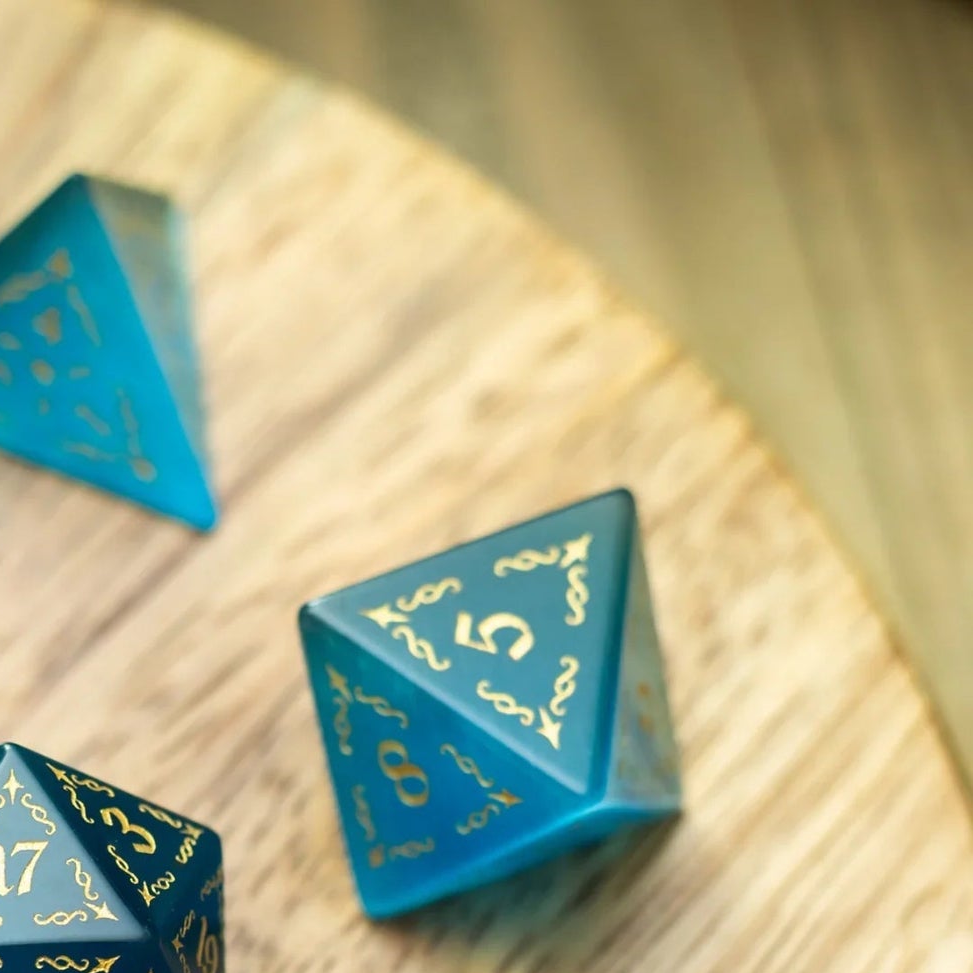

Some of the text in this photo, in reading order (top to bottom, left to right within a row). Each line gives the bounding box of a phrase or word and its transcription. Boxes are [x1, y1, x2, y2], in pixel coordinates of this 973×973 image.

[455, 610, 534, 661] 5
[378, 740, 429, 807] 8
[100, 806, 157, 855] 3
